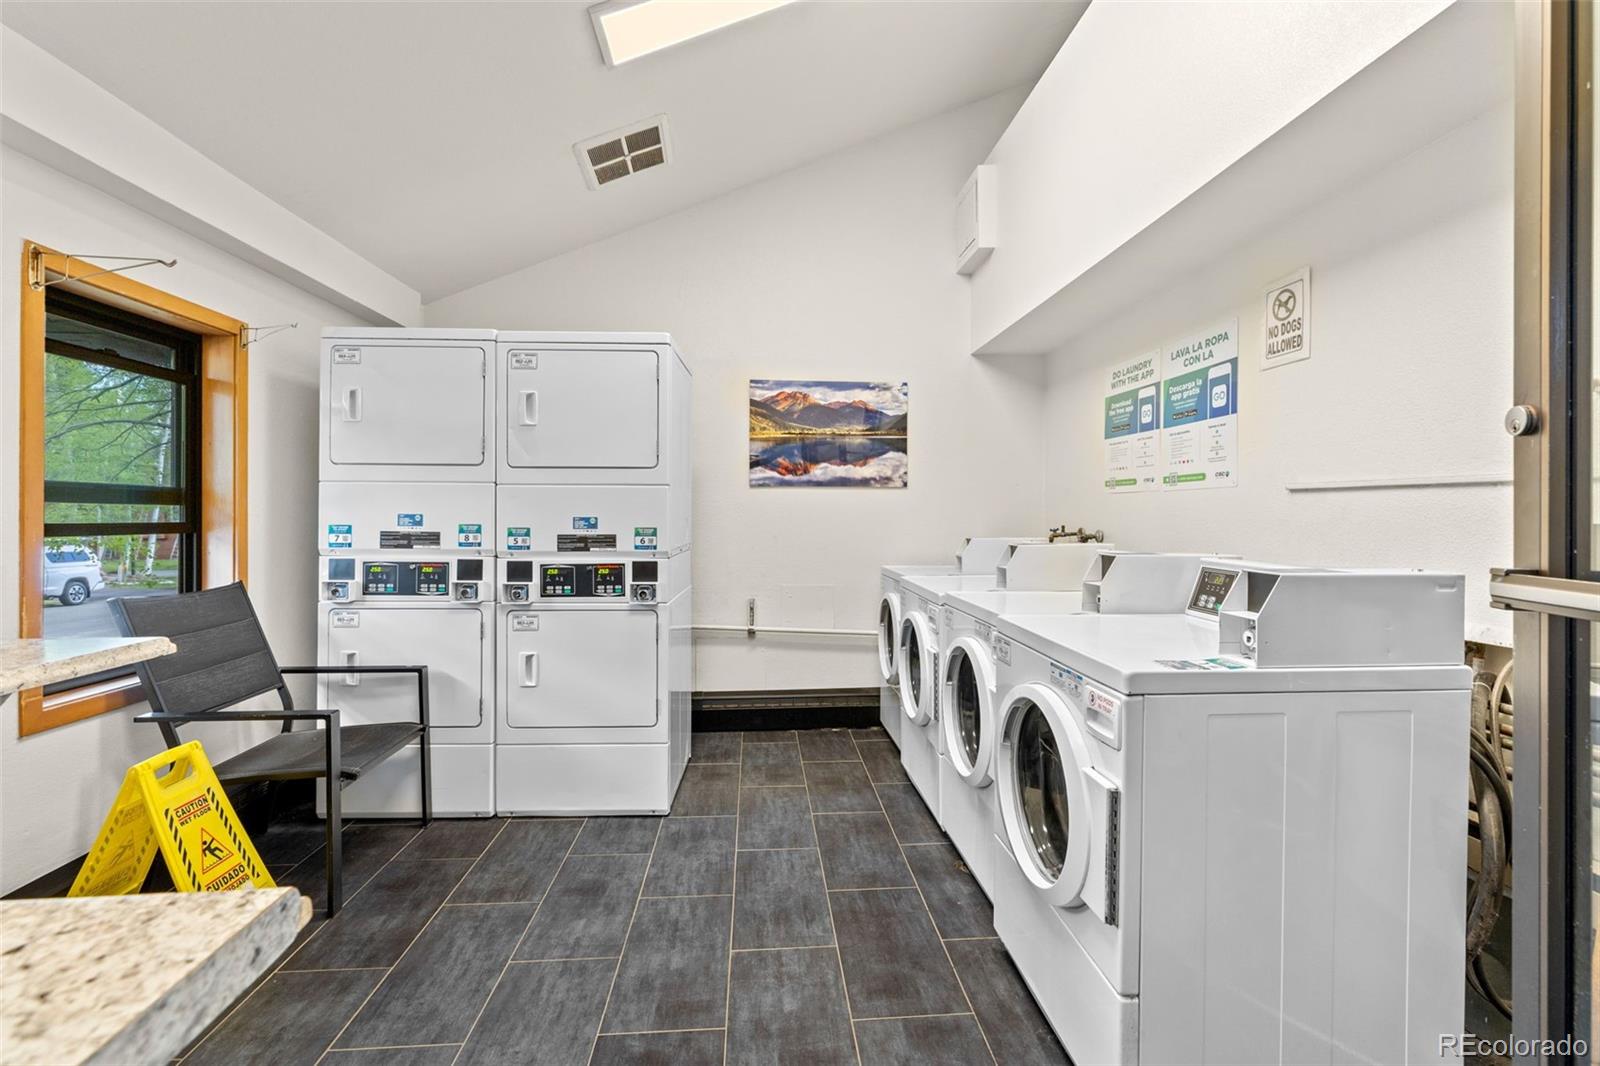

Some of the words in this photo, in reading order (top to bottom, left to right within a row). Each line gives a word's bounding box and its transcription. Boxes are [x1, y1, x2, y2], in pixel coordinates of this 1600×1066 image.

[1268, 325, 1279, 339] NO
[1281, 317, 1302, 336] DOGS
[1170, 346, 1190, 361] LAVA
[1192, 341, 1203, 353] LA
[1205, 331, 1229, 348] ROPA
[1268, 334, 1303, 354] ALLOWED
[1112, 370, 1122, 380] DO
[1122, 358, 1153, 377] LAUNDRY
[1183, 353, 1201, 368] CON
[1203, 349, 1214, 361] LA
[1111, 377, 1126, 390] WITH
[1127, 373, 1140, 385] THE
[1141, 368, 1154, 380] APP
[1169, 381, 1196, 394] Descarga
[1170, 393, 1182, 401] app
[1213, 391, 1226, 402] GO
[175, 796, 209, 818] CAUTION
[180, 817, 193, 827] WET
[193, 806, 211, 819] FLOOR
